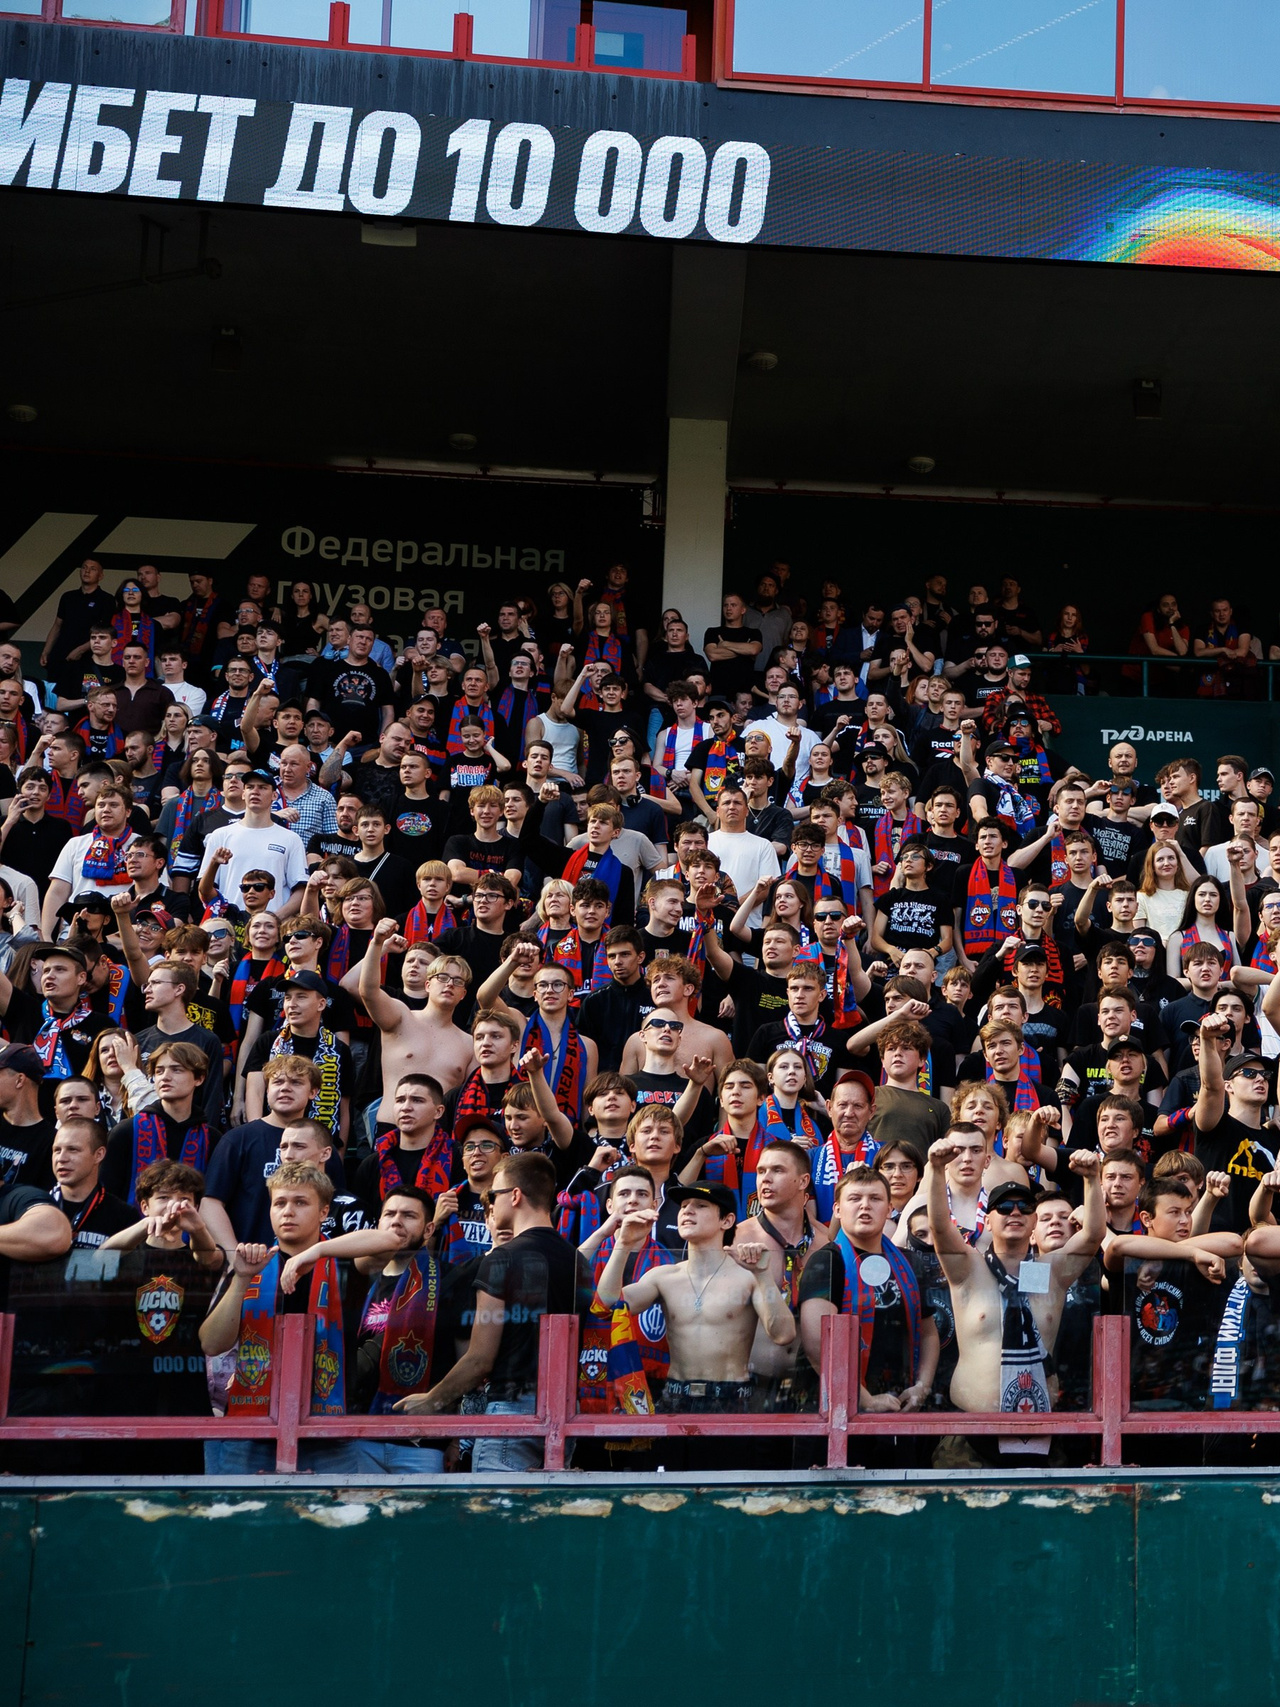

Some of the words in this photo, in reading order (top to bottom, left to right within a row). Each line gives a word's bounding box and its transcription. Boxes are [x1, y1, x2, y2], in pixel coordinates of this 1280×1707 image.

[263, 102, 421, 216] ДО
[446, 119, 555, 227] 10
[574, 130, 771, 243] 000
[281, 525, 565, 574] Федеральная
[931, 740, 954, 749] Ree
[1146, 731, 1194, 743] АРЕНА
[1002, 907, 1017, 919] ЦСК
[636, 1090, 682, 1104] МОСК
[137, 1290, 182, 1312] ЦСКА
[1211, 1347, 1238, 1398] ФЛАГ
